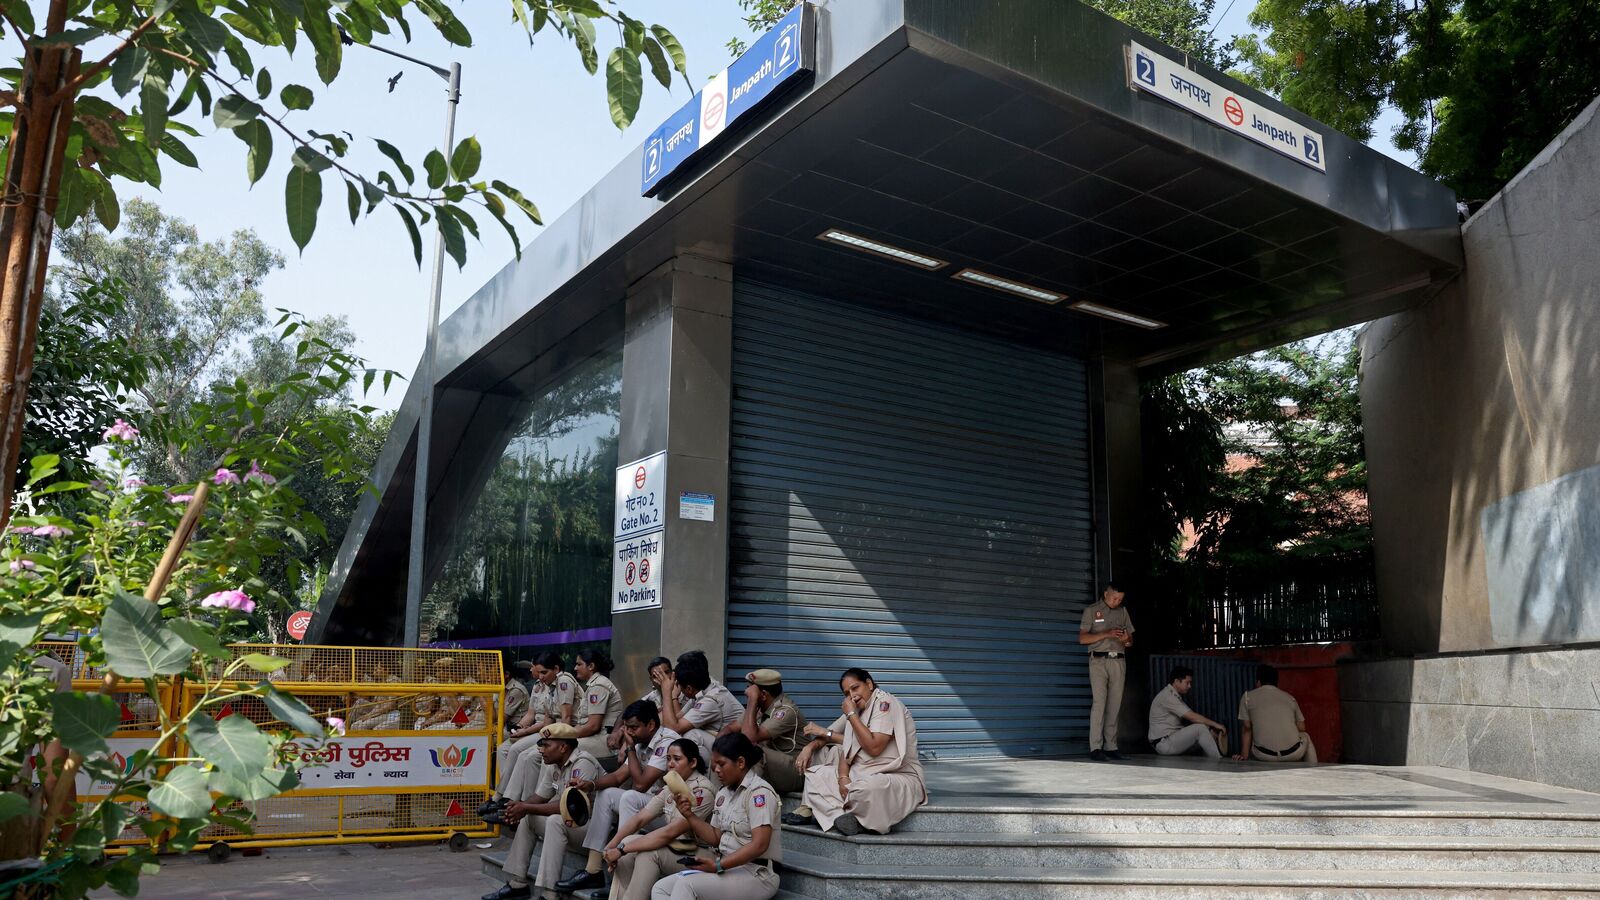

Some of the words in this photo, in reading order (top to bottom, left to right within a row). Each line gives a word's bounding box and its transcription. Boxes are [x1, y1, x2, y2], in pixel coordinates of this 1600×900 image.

[779, 35, 791, 67] 2
[730, 59, 772, 105] Janpath
[1140, 58, 1152, 83] 2
[1169, 72, 1212, 107] जनपथ
[666, 119, 694, 153] जनपथ
[1251, 114, 1297, 148] Janpath
[648, 147, 657, 175] 2
[1306, 139, 1317, 162] 2
[625, 494, 636, 513] गेट
[649, 491, 655, 506] 2
[621, 515, 638, 531] Gate
[639, 513, 652, 527] No.
[653, 508, 658, 523] 2
[618, 591, 629, 604] No
[629, 587, 656, 603] Parking
[348, 741, 412, 768] पुलिस
[334, 770, 355, 780] सेवा
[383, 770, 409, 779] न्याय
